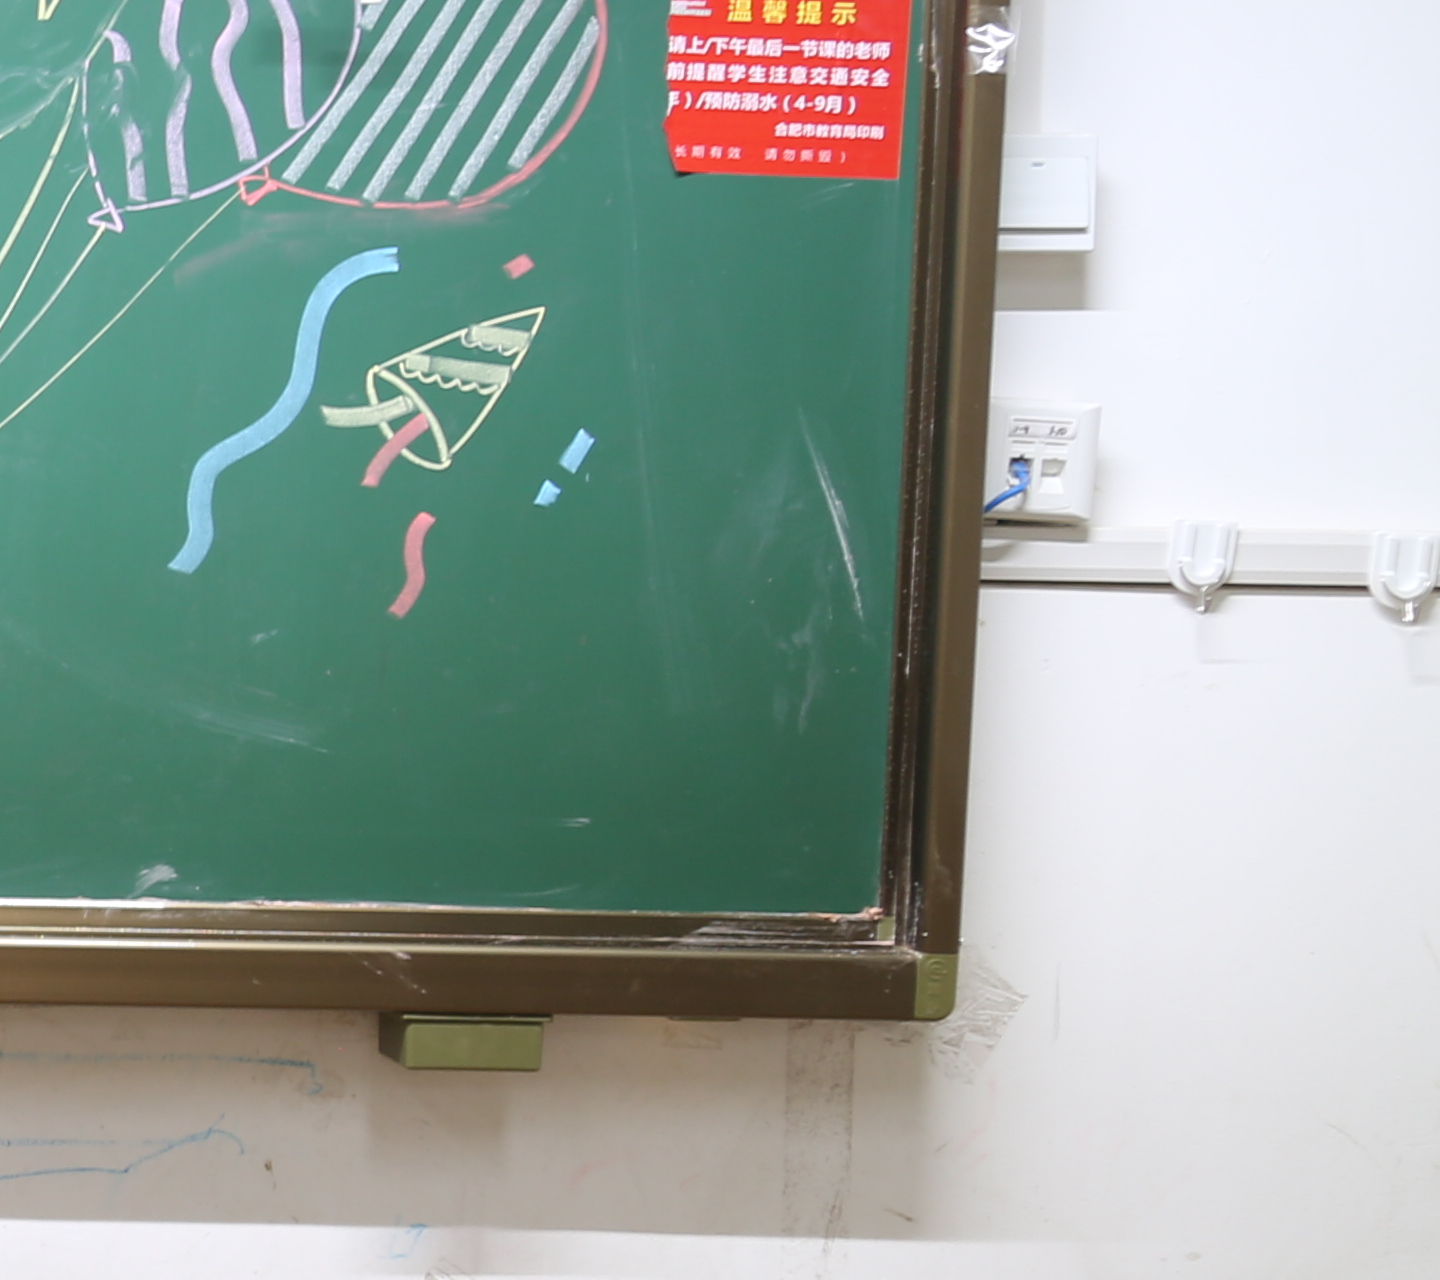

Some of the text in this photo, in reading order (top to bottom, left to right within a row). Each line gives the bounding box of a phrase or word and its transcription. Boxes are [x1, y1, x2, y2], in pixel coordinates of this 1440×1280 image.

[666, 61, 891, 88] 前提醒学生注意交通安全
